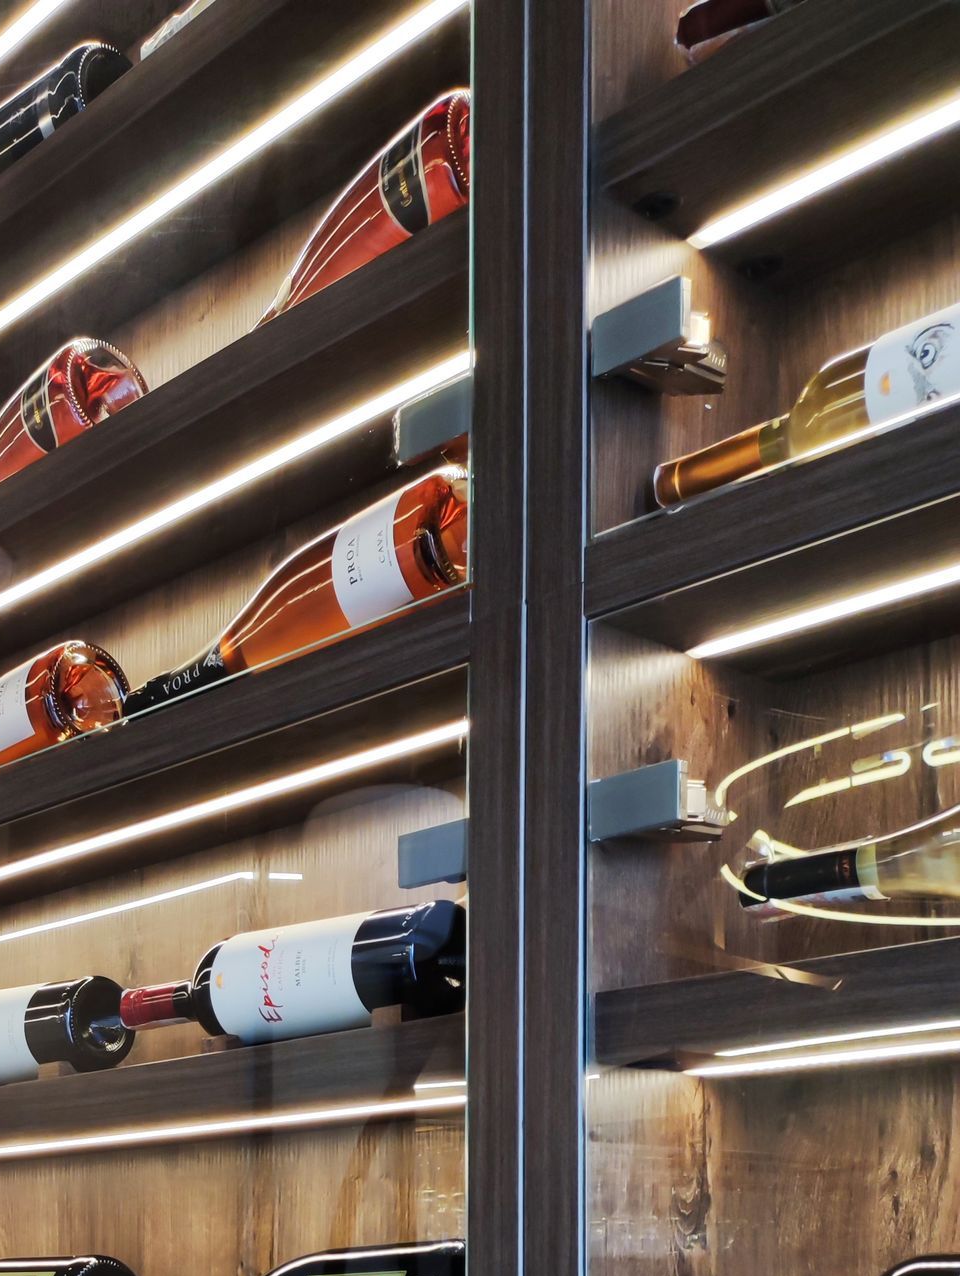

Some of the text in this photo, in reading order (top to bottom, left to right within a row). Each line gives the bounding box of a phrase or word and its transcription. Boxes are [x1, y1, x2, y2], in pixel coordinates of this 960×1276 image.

[346, 537, 358, 586] PROA
[376, 530, 386, 564] CAVA
[162, 663, 201, 695] PROA
